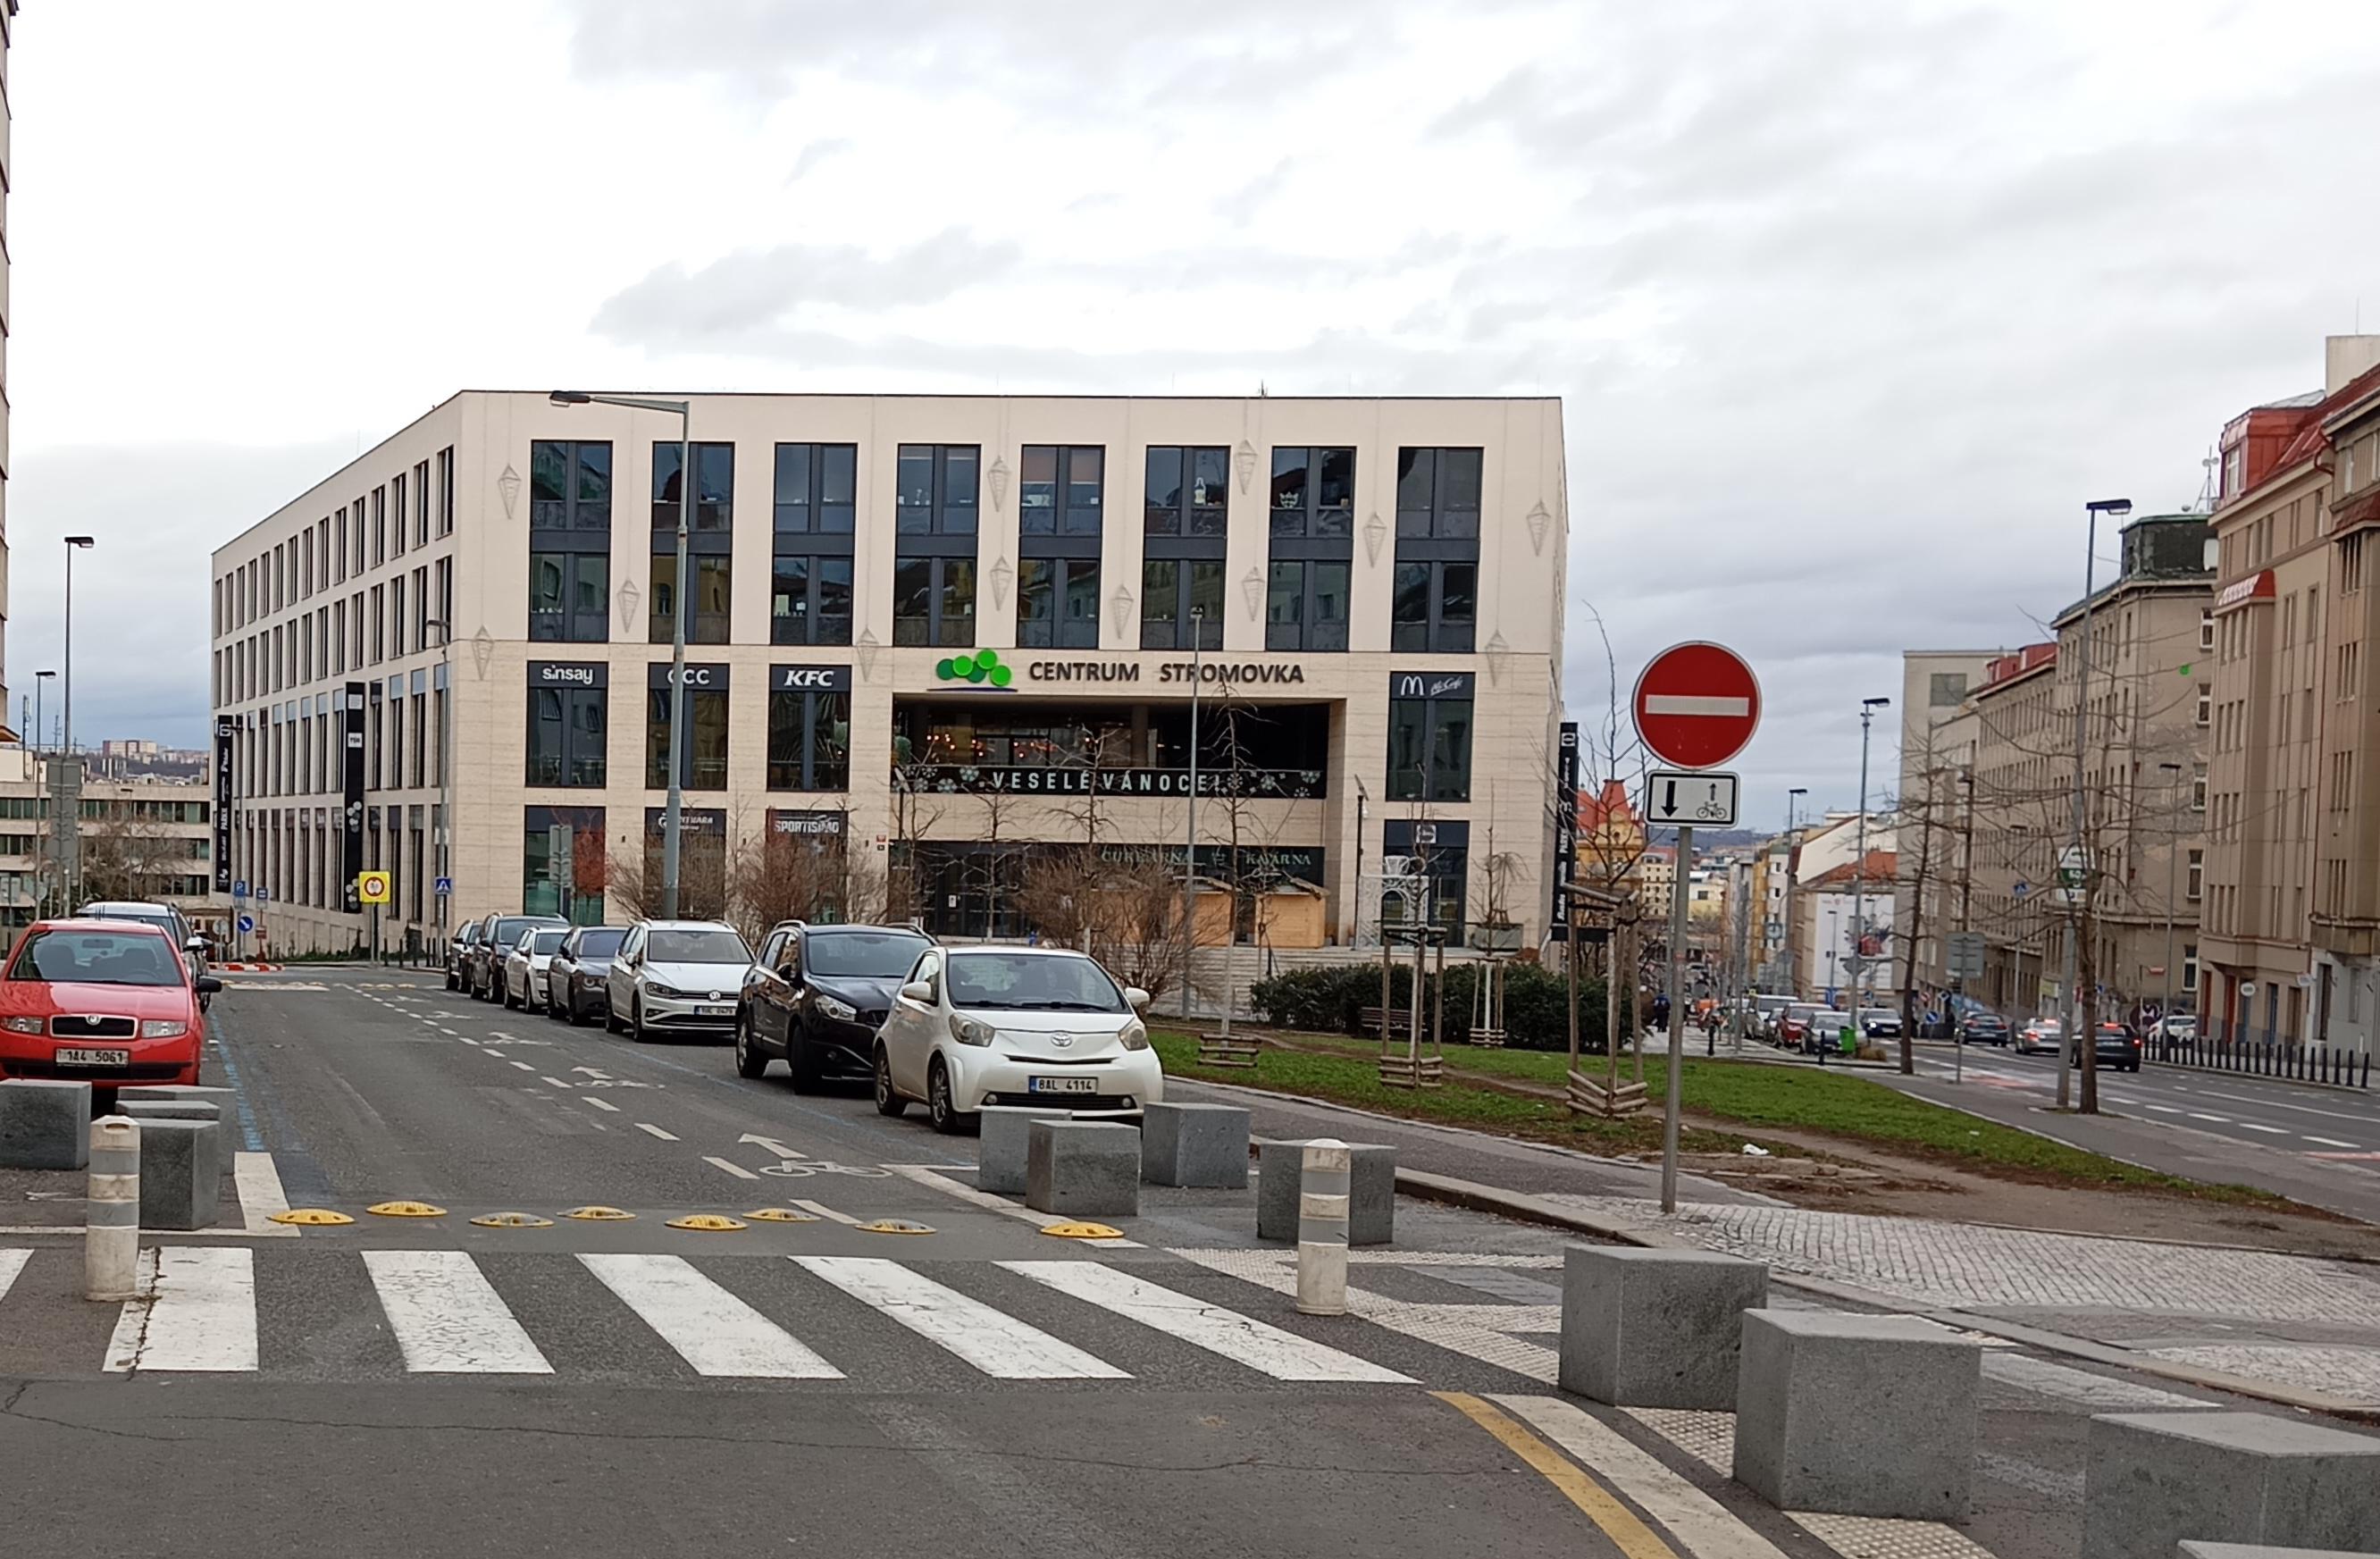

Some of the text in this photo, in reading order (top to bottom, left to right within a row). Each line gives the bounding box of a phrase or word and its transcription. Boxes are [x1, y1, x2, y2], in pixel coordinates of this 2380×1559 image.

[542, 666, 594, 685] sinsay
[784, 670, 834, 687] KFC
[1029, 661, 1304, 684] CENTRUM STROMOVKA
[993, 769, 1222, 792] VESELÉ VÁNOCE!
[95, 1052, 122, 1062] 5061
[1039, 1079, 1092, 1090] 8AL 4114
